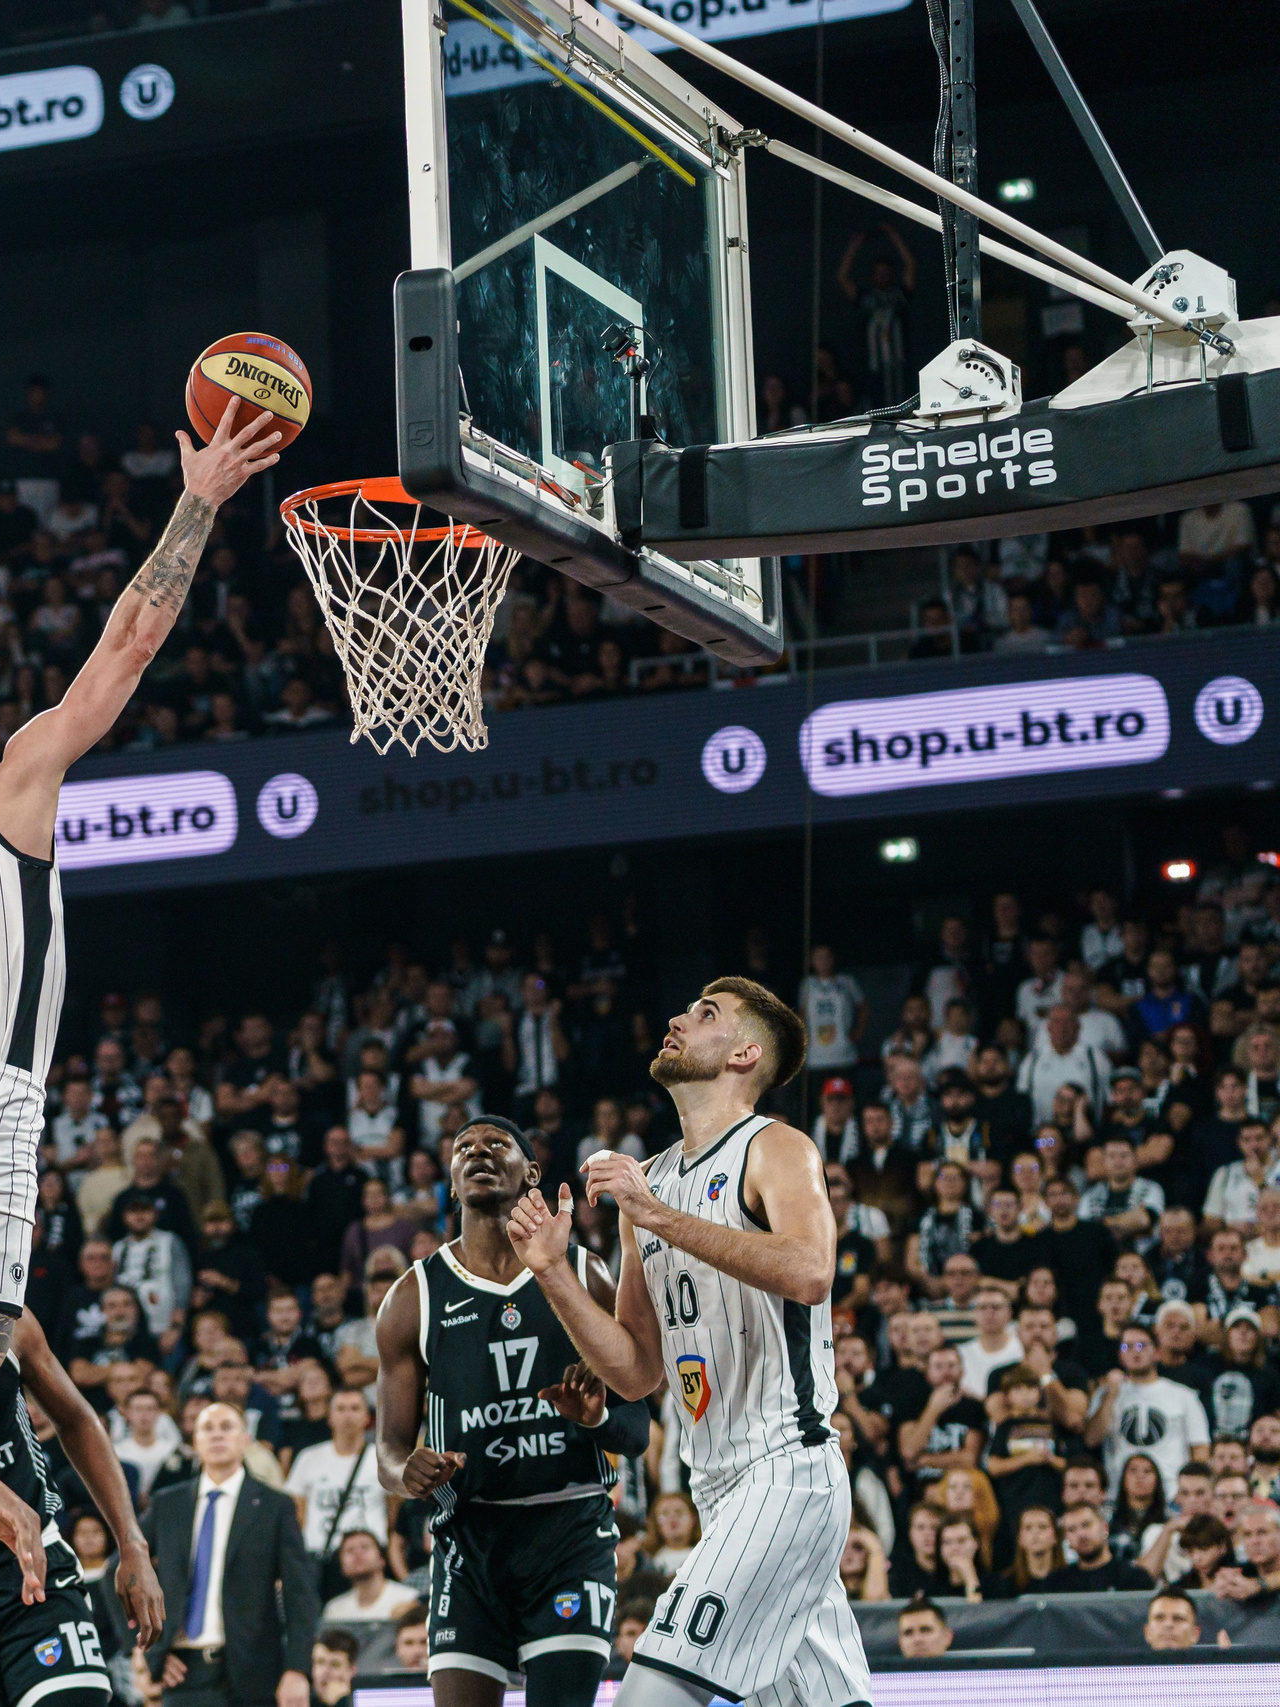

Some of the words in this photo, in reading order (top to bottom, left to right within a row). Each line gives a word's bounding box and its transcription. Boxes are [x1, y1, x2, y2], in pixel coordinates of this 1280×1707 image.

[224, 356, 303, 410] SPALDING
[861, 427, 1054, 475] Schelde
[861, 459, 1058, 512] Sports
[824, 708, 1146, 768] shop.u-bt.ro
[57, 803, 215, 842] u-bt.ro
[663, 1270, 701, 1331] 10
[488, 1336, 540, 1392] 17
[681, 1371, 702, 1395] BT
[460, 1396, 561, 1433] MOZZA
[517, 1431, 567, 1459] NIS
[583, 1580, 616, 1634] 17
[651, 1583, 729, 1650] 10
[58, 1620, 107, 1669] 12
[435, 1629, 457, 1646] mts
